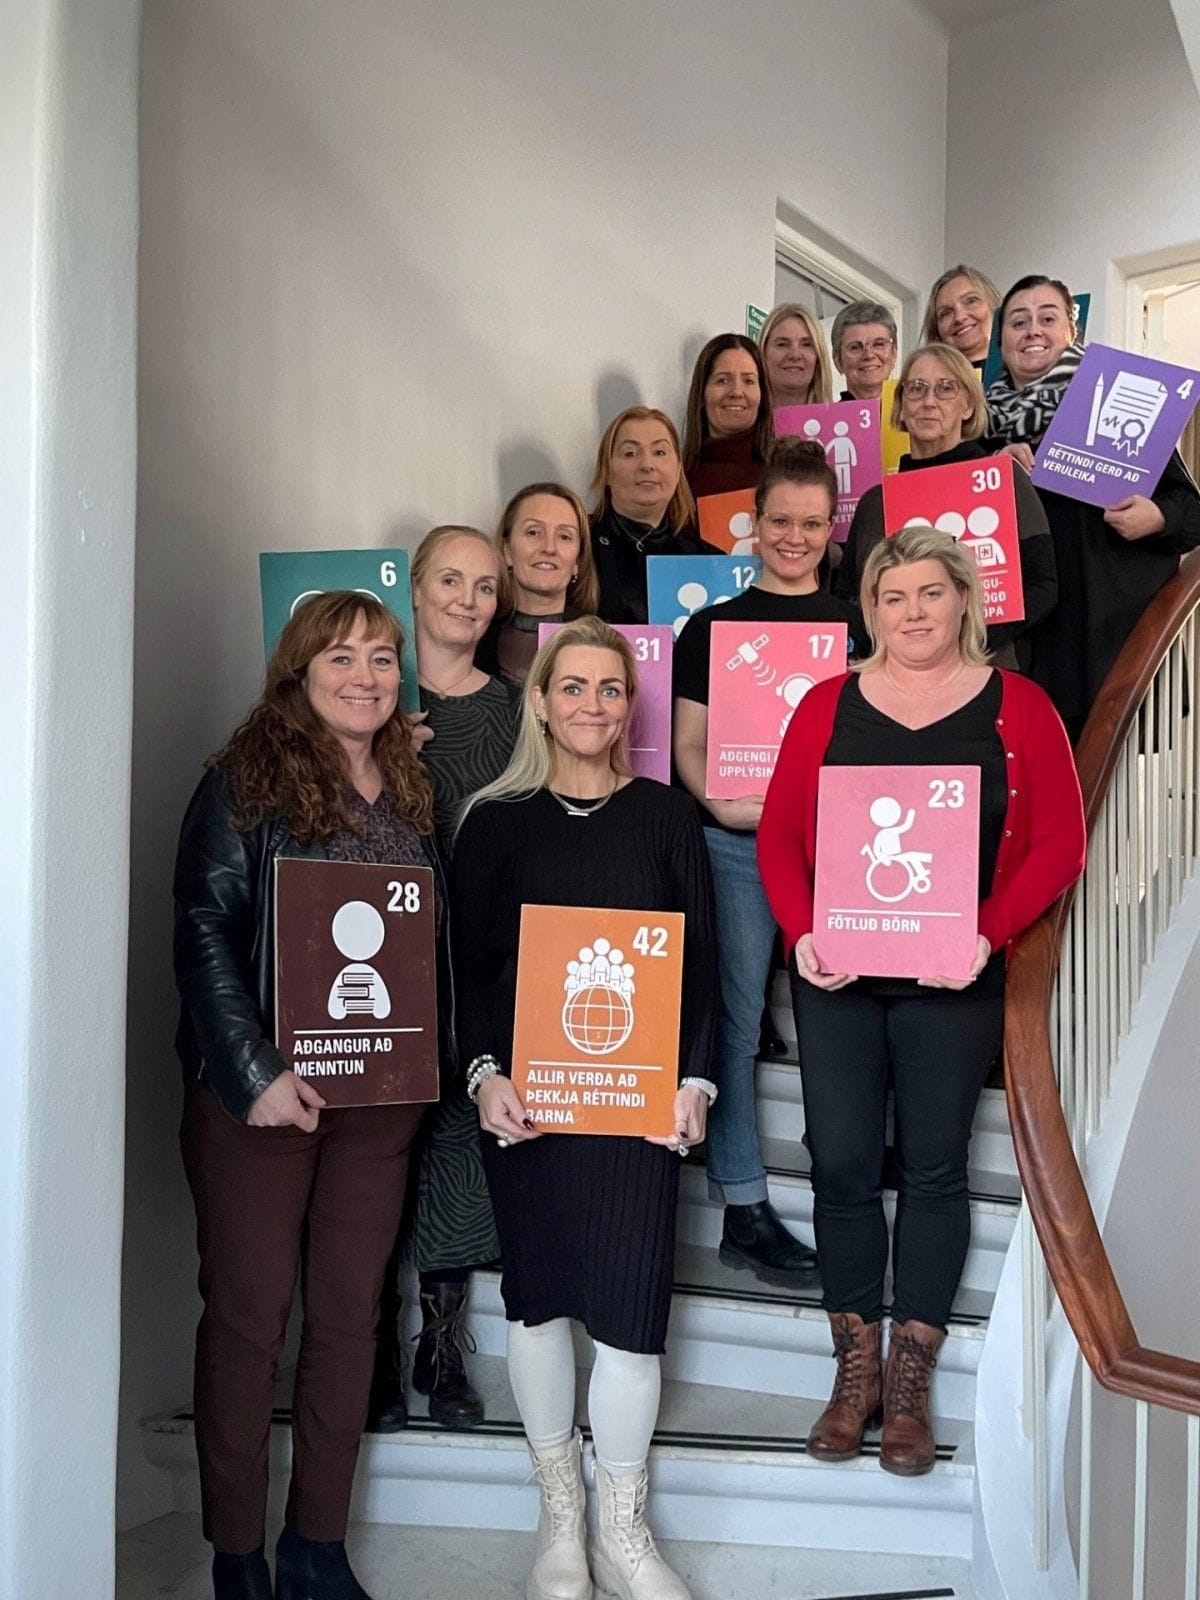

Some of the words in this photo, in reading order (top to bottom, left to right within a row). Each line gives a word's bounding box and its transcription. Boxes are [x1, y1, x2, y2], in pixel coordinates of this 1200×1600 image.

[1176, 379, 1195, 400] 4
[859, 409, 871, 428] 3
[971, 467, 1001, 493] 30
[1042, 458, 1096, 484] VERULEIKA
[380, 560, 397, 587] 6
[732, 566, 756, 589] 12
[634, 637, 661, 662] 31
[808, 634, 835, 660] 17
[719, 765, 775, 778] UPPLÝSIN
[928, 779, 965, 809] 23
[386, 881, 421, 913] 28
[881, 916, 921, 933] BÖRN
[632, 926, 669, 957] 42
[293, 1038, 371, 1055] AÐGANGUR
[373, 1037, 393, 1053] AÐ
[293, 1060, 365, 1077] MENNTUN
[526, 1069, 565, 1084] ALLIR
[569, 1071, 614, 1087] VERÐA
[617, 1074, 638, 1087] AÐ
[526, 1089, 579, 1105] ÞEKKJA
[583, 1088, 646, 1108] RÉTTINDI
